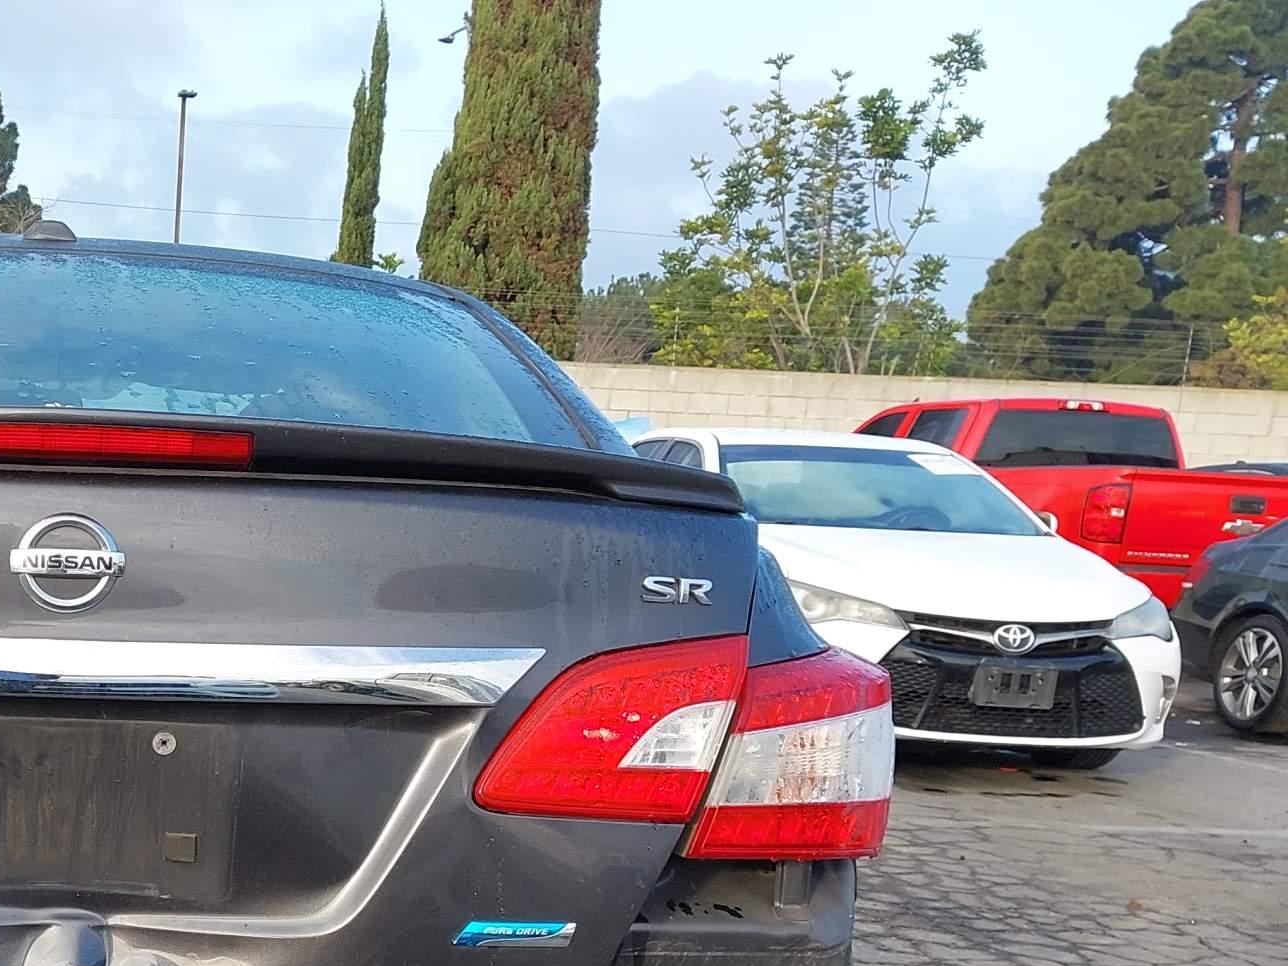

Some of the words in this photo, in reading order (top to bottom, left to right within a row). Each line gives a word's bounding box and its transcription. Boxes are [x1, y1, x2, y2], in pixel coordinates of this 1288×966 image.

[22, 554, 113, 571] NISSAN
[640, 576, 713, 606] SR
[515, 927, 550, 936] DRIVE
